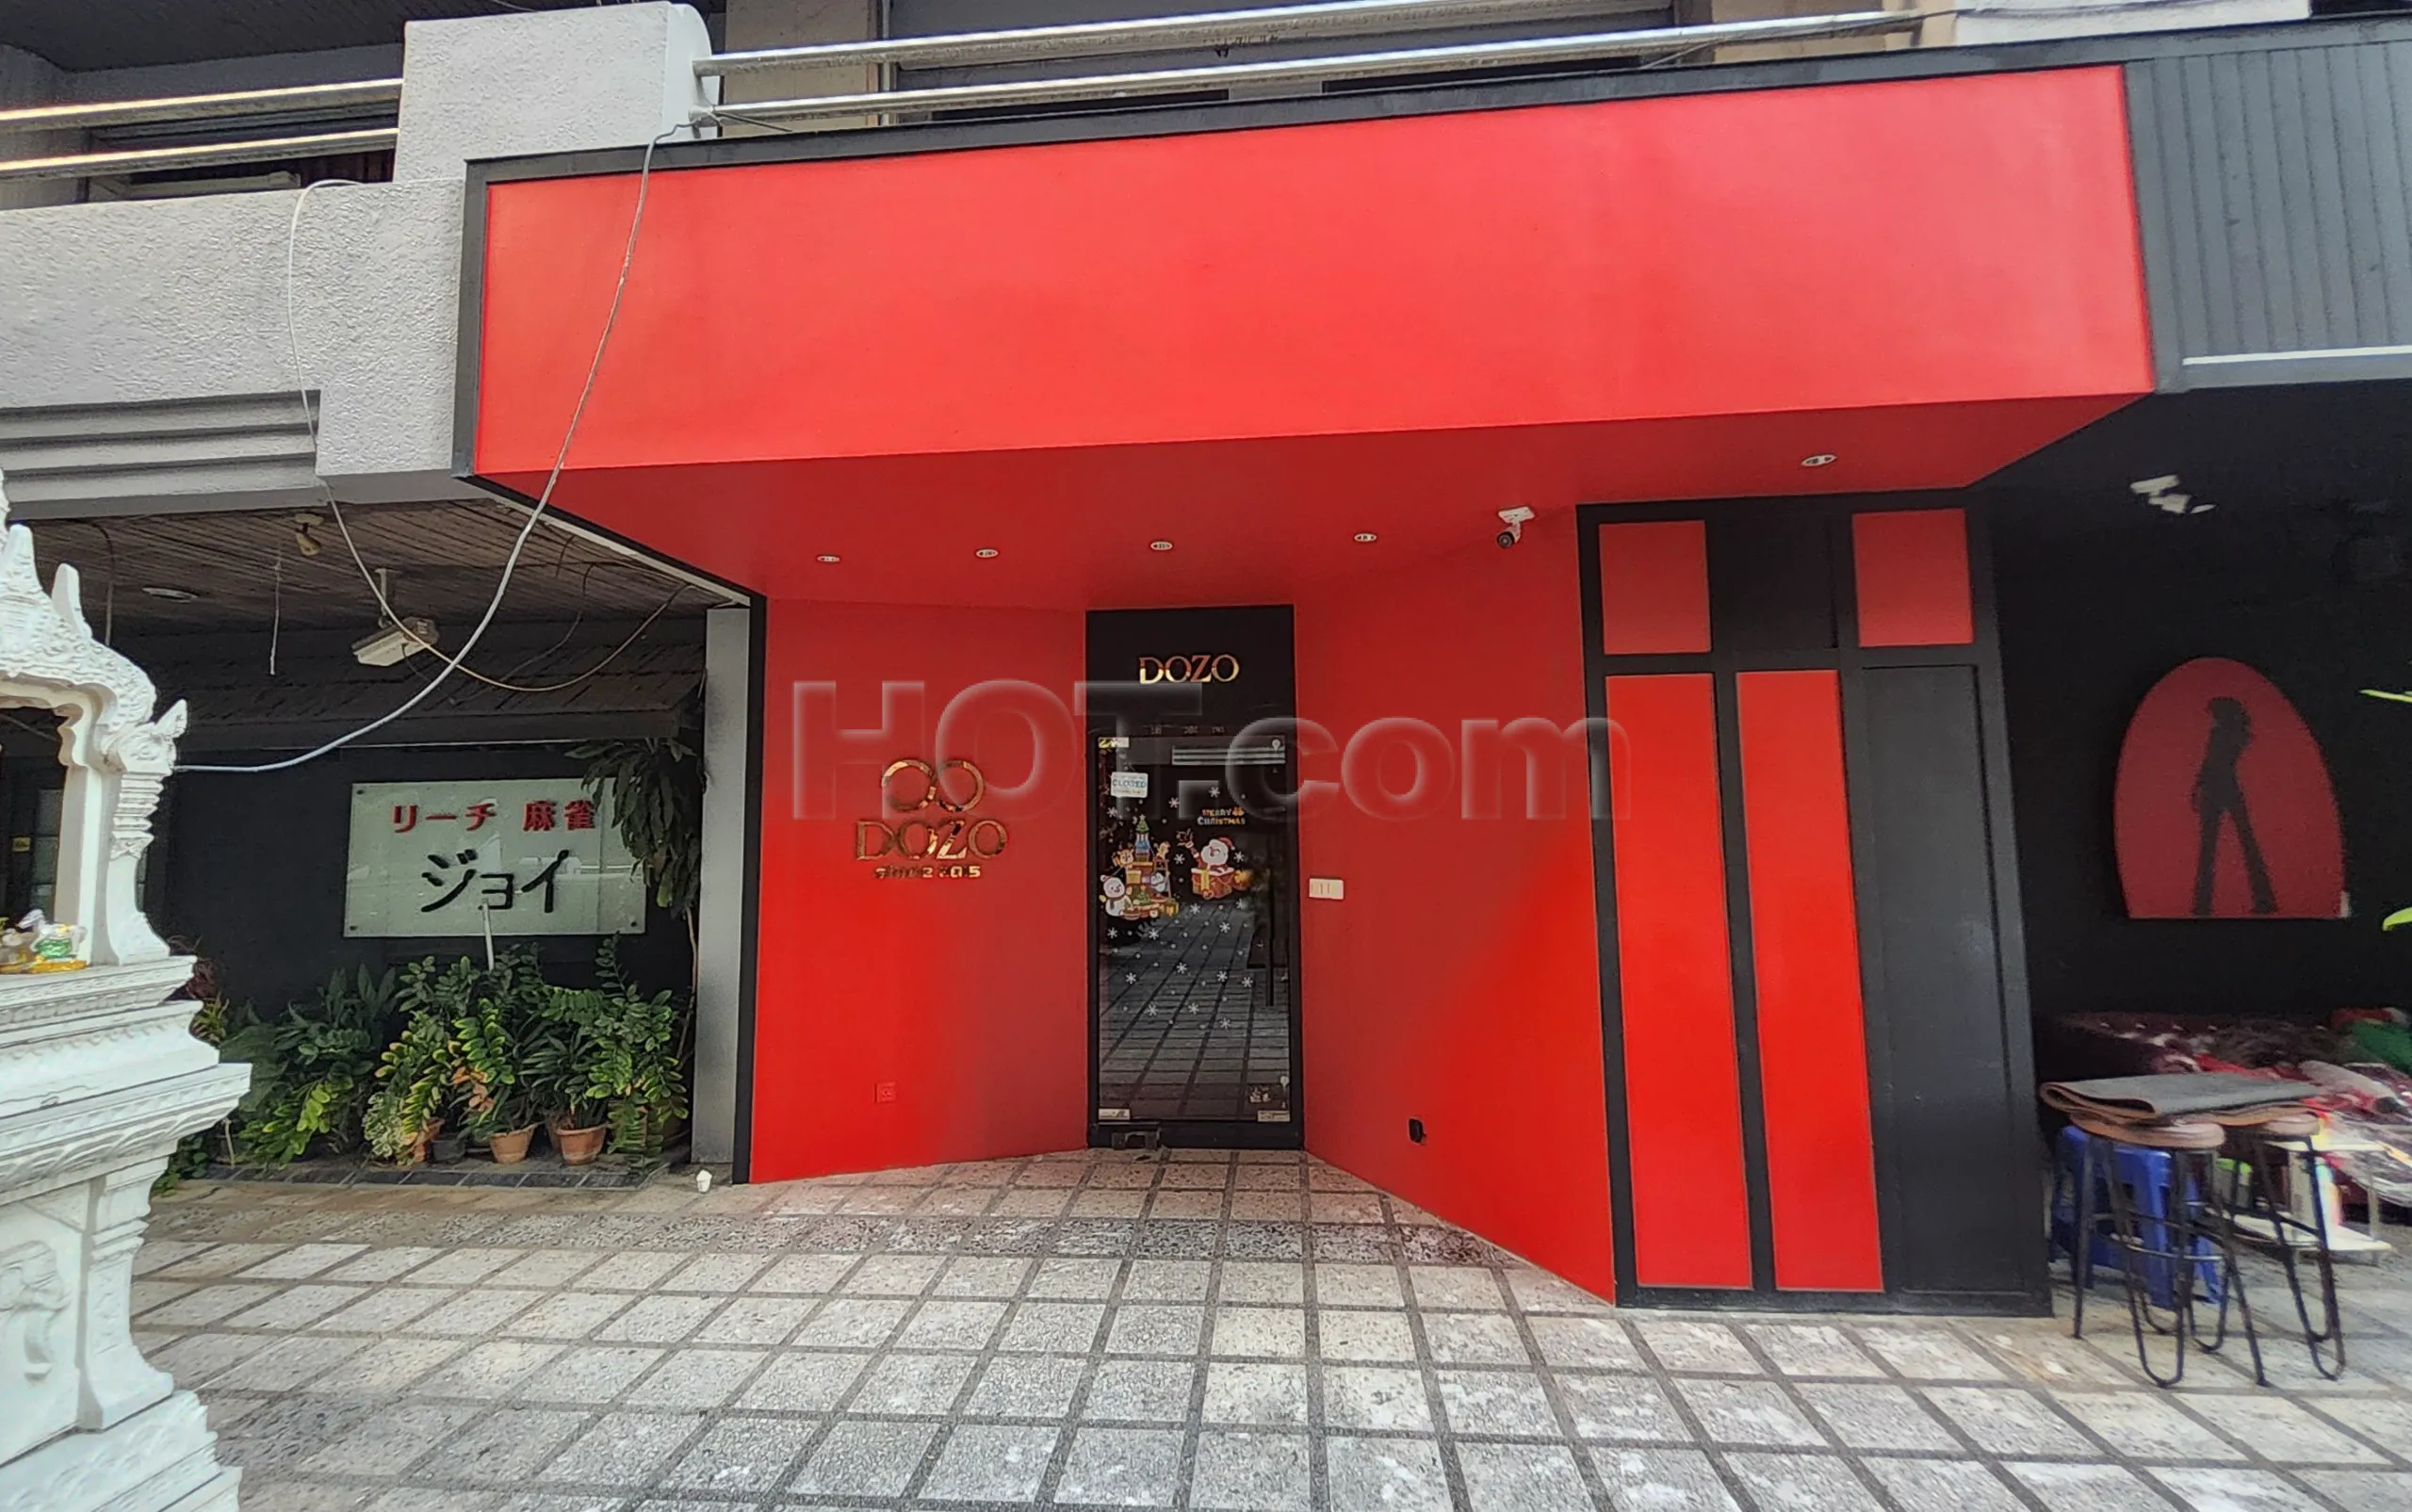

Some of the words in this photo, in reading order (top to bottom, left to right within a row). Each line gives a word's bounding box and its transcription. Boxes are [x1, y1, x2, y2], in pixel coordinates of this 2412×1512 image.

[1138, 653, 1240, 685] DOZO
[392, 802, 497, 833] リーチ
[522, 799, 596, 833] 麻雀
[856, 819, 1008, 860] DOZO
[420, 849, 570, 913] ジョイ
